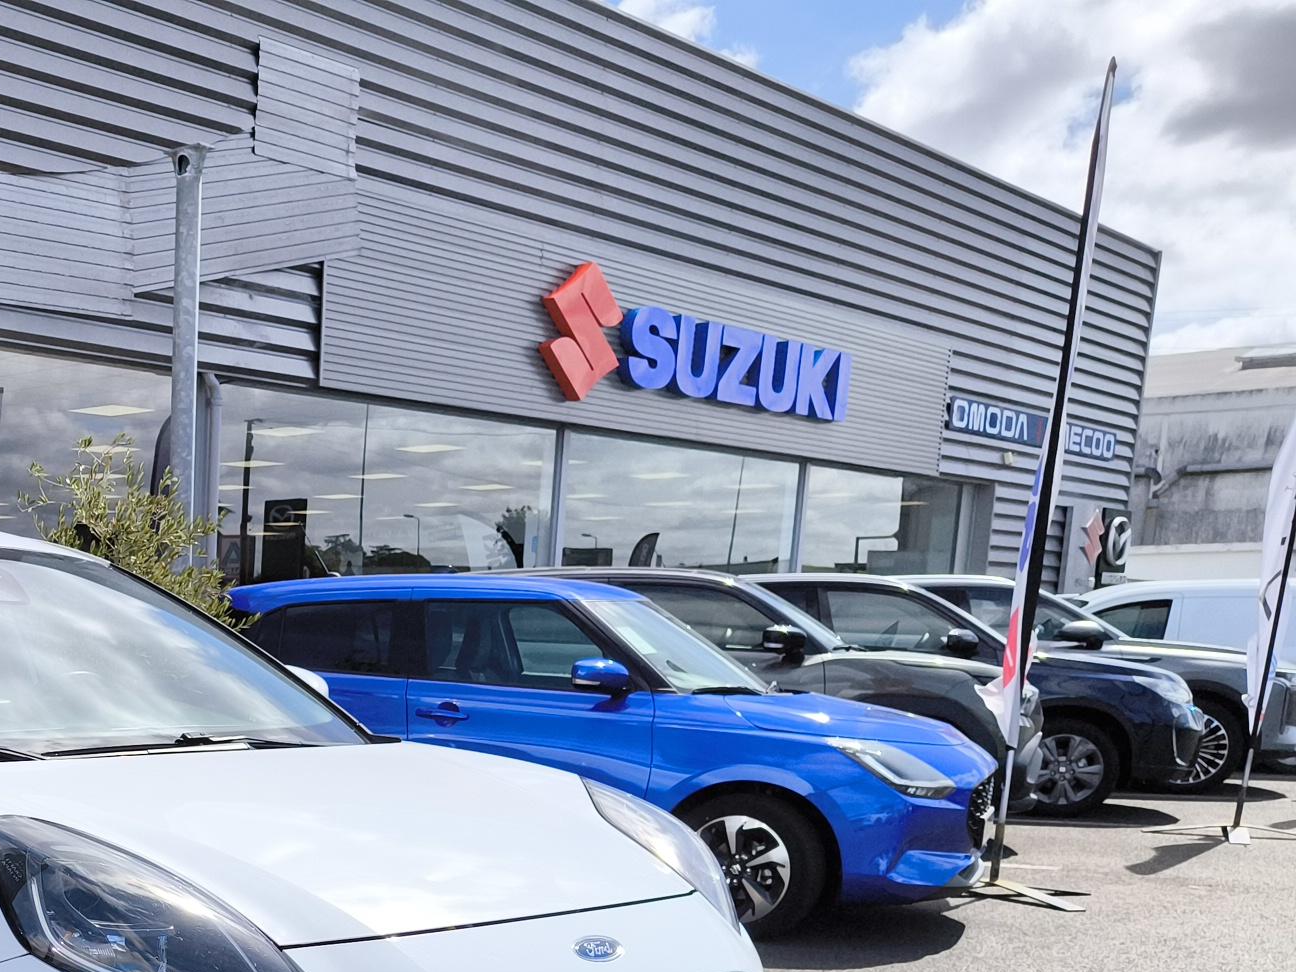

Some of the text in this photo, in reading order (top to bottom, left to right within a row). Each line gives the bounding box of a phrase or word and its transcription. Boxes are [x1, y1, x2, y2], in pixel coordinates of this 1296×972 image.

[624, 306, 852, 423] SUZUKI
[952, 399, 1028, 441] OMODA
[583, 940, 614, 957] Ford
